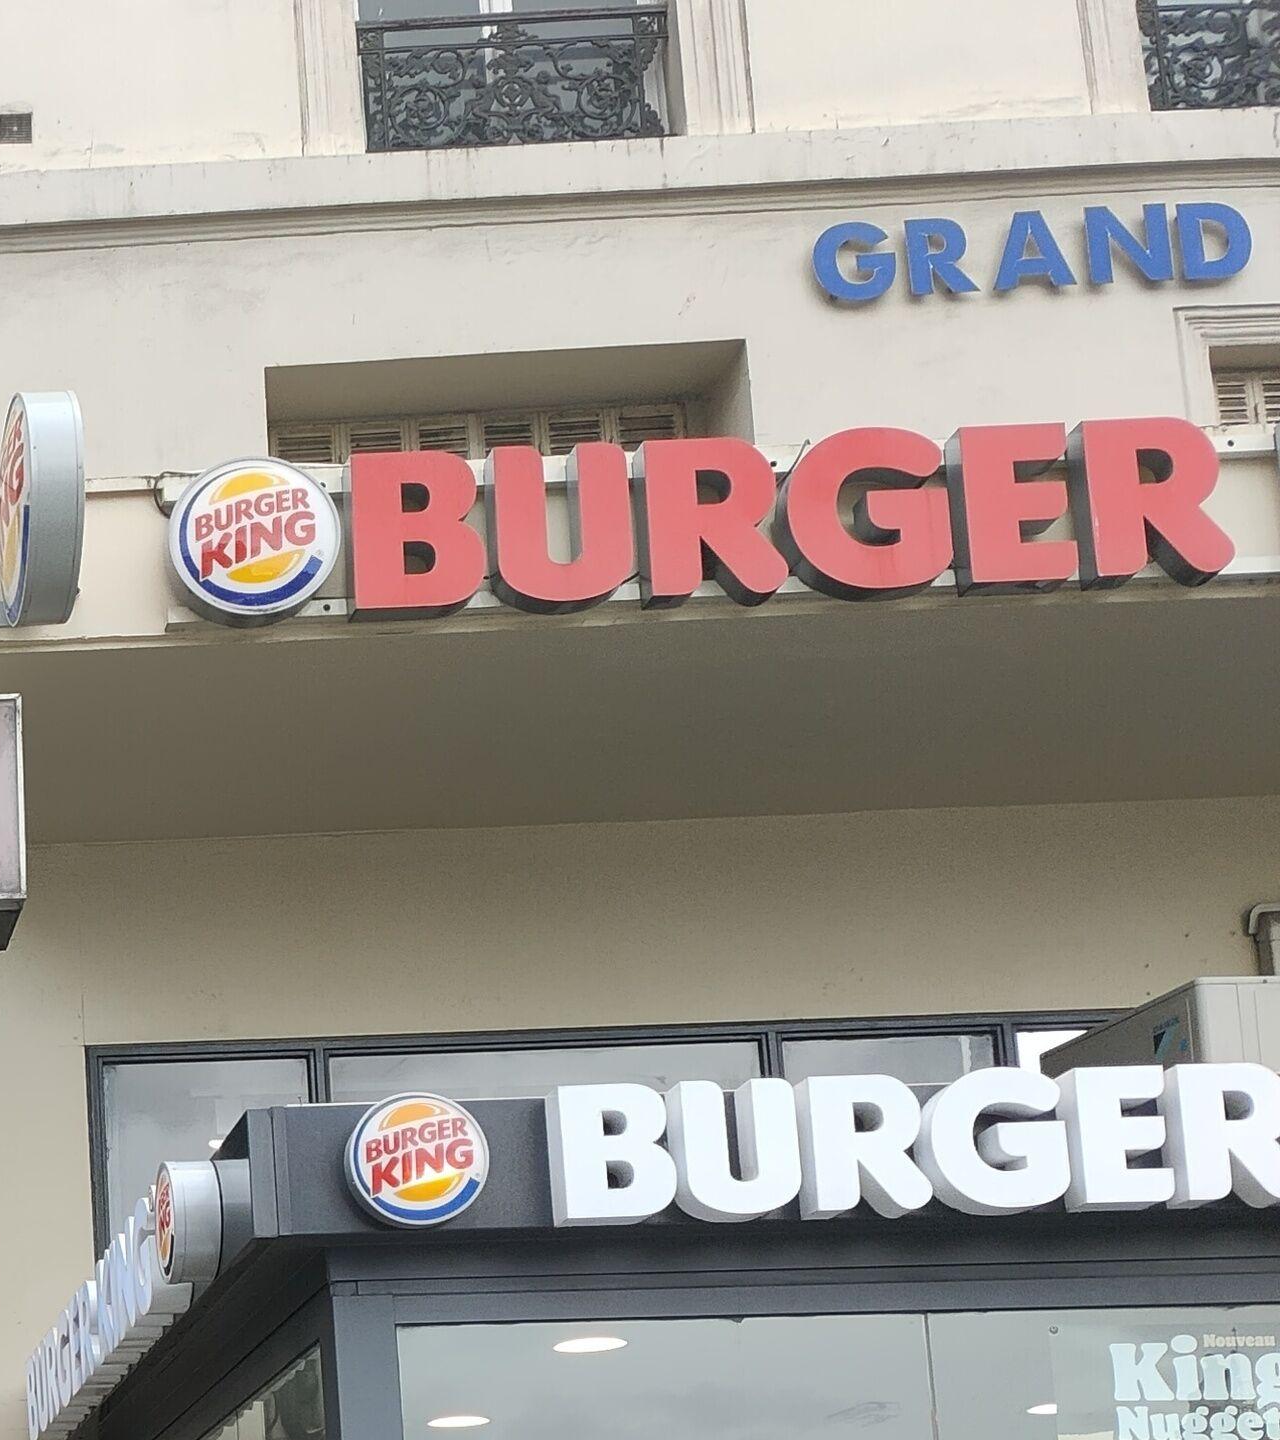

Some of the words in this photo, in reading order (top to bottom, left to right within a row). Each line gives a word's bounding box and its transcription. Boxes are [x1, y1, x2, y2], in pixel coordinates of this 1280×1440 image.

[813, 202, 1252, 302] GRAND
[195, 488, 310, 542] BURGER
[200, 511, 315, 579] KING
[349, 417, 1236, 611] BURGER
[365, 1117, 469, 1163] BURGER
[371, 1138, 474, 1196] KING
[548, 1062, 1280, 1227] BURGER
[1203, 1334, 1277, 1348] Nouveau
